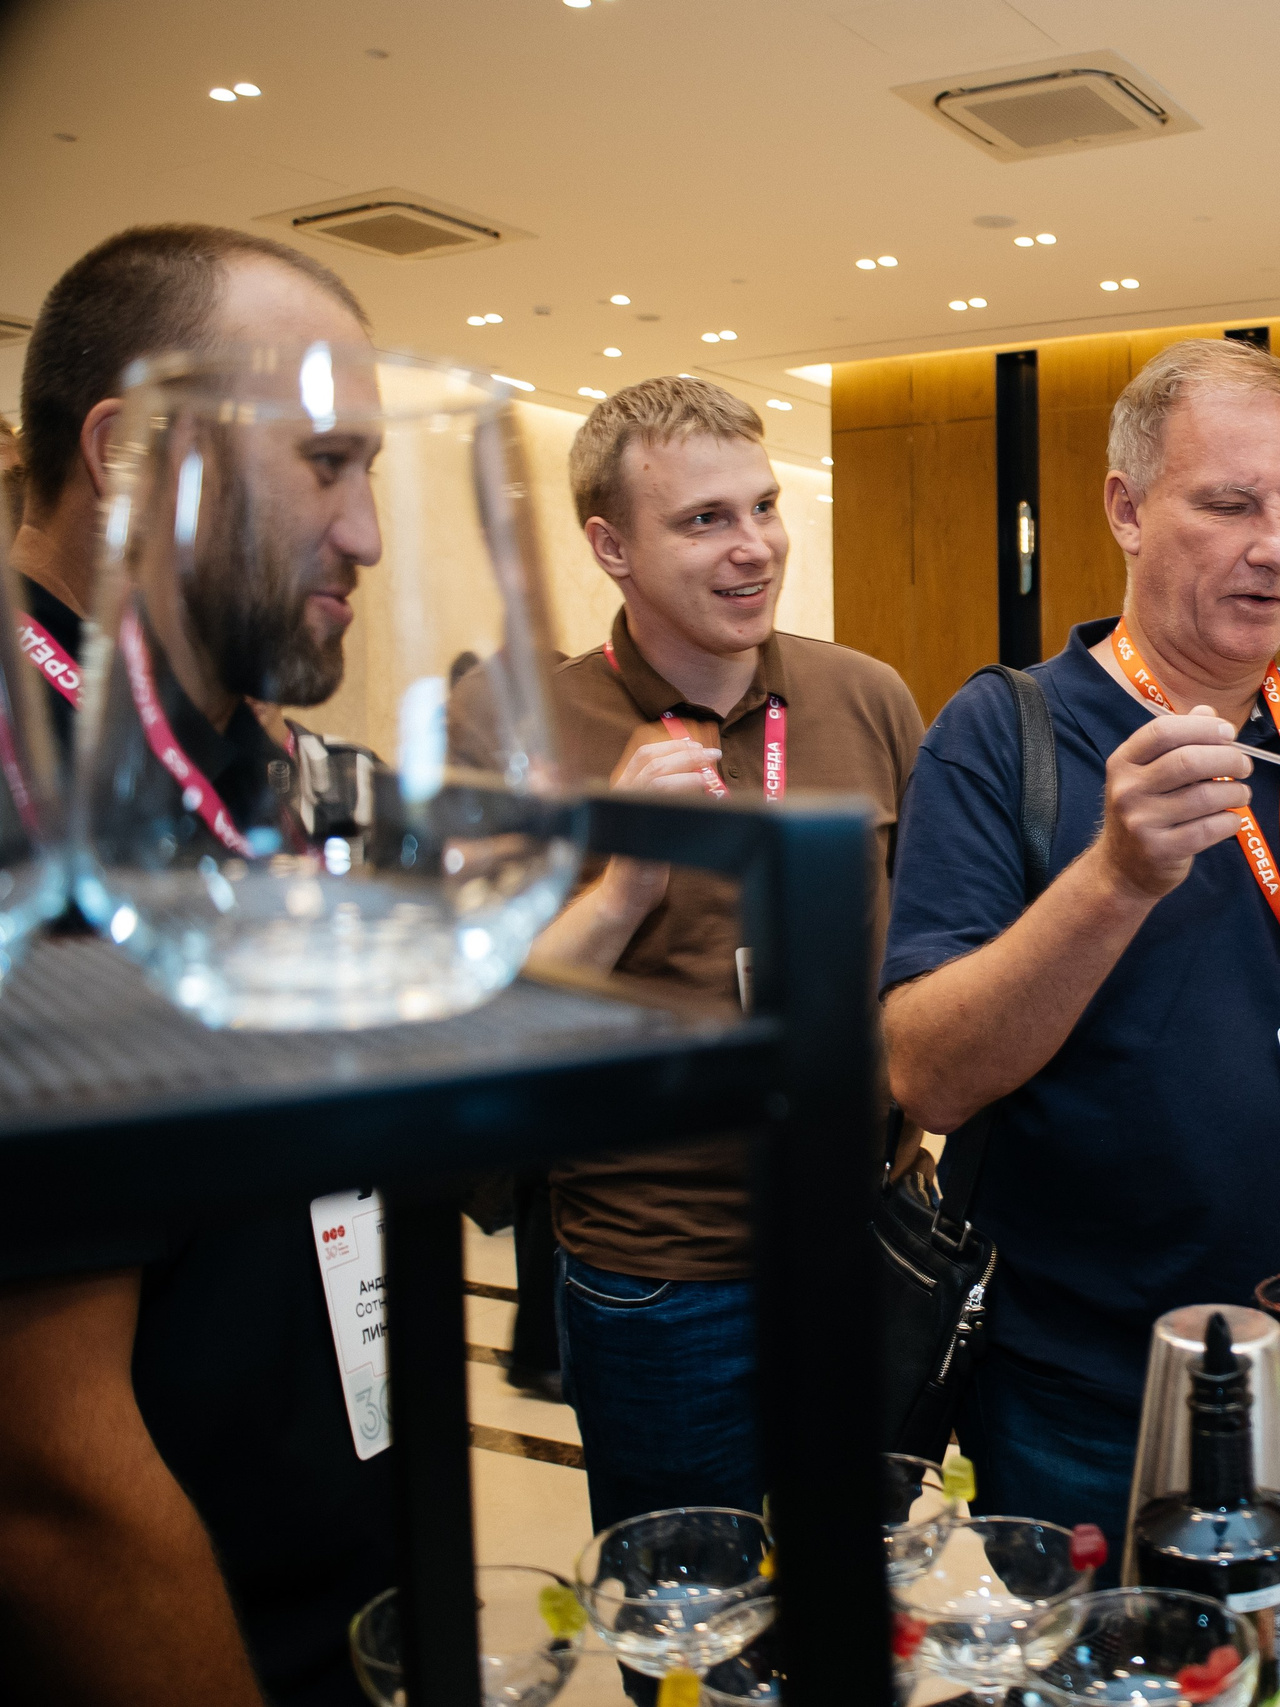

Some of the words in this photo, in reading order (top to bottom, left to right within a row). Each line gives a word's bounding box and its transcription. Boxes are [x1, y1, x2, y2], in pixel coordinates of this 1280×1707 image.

[1117, 636, 1135, 661] OCS
[1262, 676, 1280, 703] OCS
[766, 742, 783, 802] T-СРЕДА
[360, 1275, 388, 1295] Анд
